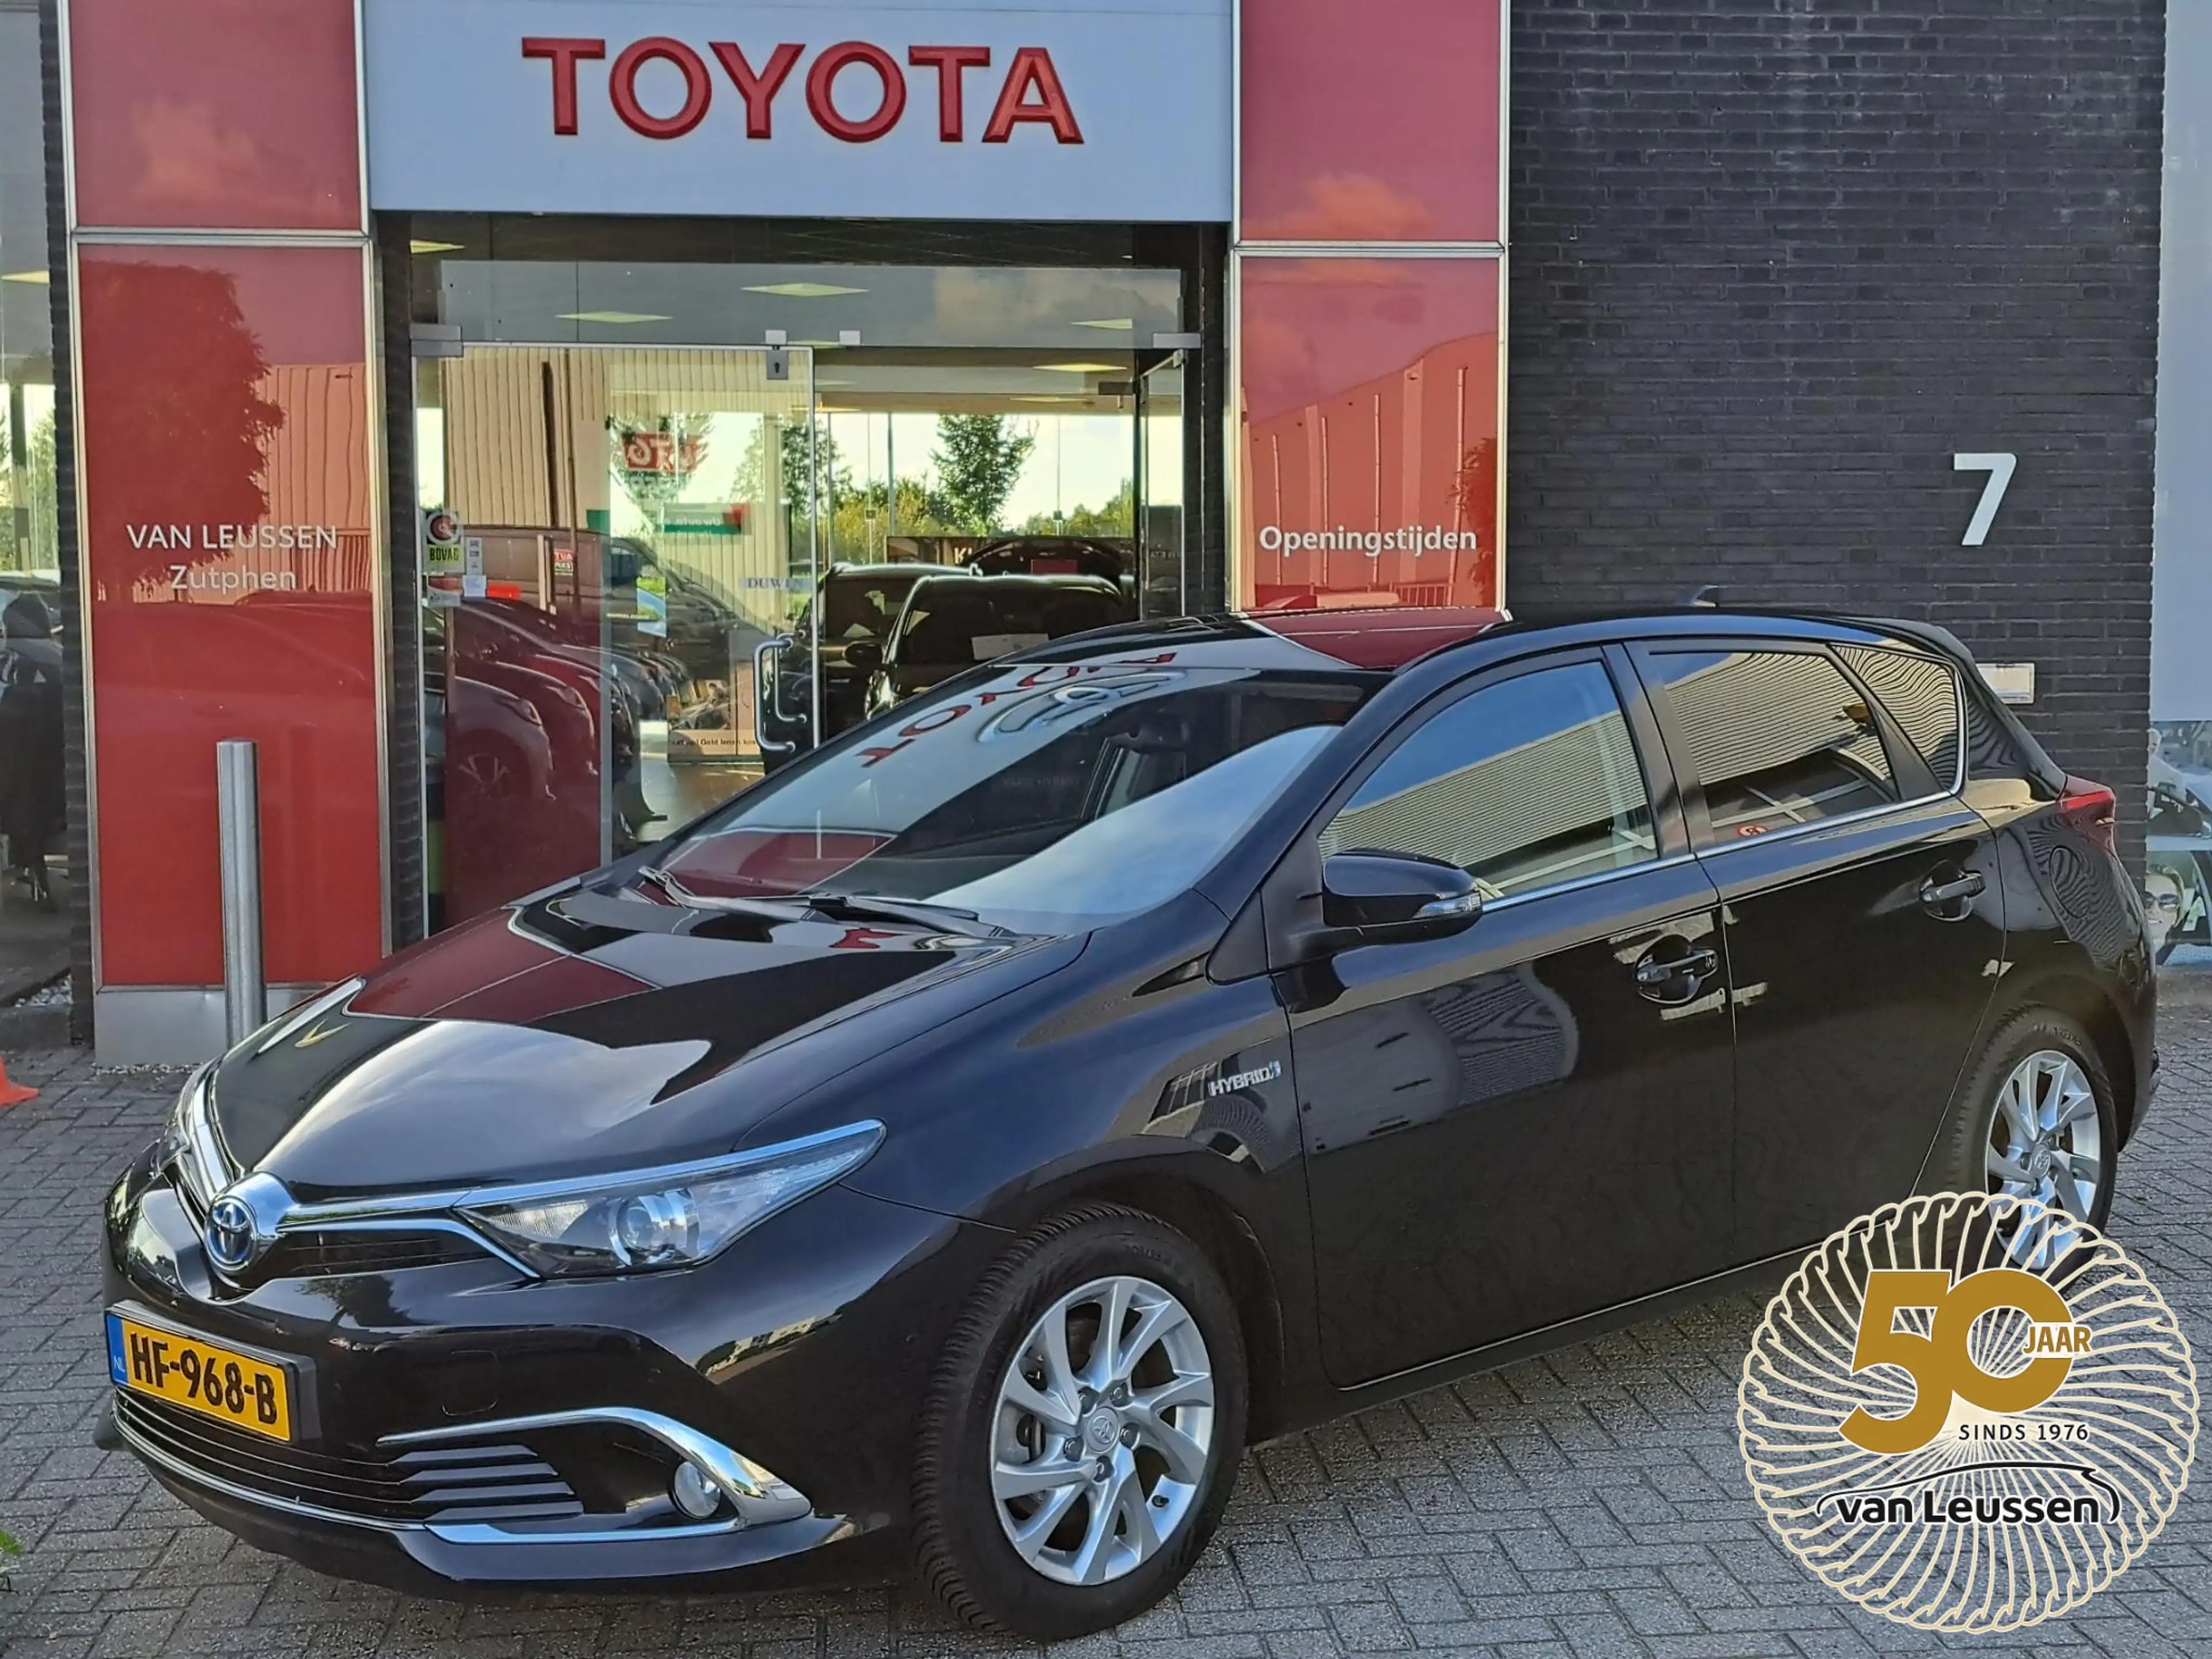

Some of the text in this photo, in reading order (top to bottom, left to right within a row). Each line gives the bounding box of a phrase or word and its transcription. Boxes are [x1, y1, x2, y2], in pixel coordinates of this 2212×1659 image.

[522, 36, 1084, 144] TOYOTA
[1954, 453, 2016, 546] 7
[127, 524, 337, 550] VAN LEUSSEN
[1259, 525, 1478, 557] Openingstijden
[171, 565, 297, 594] Zutphen
[1209, 1067, 1272, 1097] HYBRID
[113, 1355, 126, 1372] NL
[130, 1332, 278, 1425] HF-968-B
